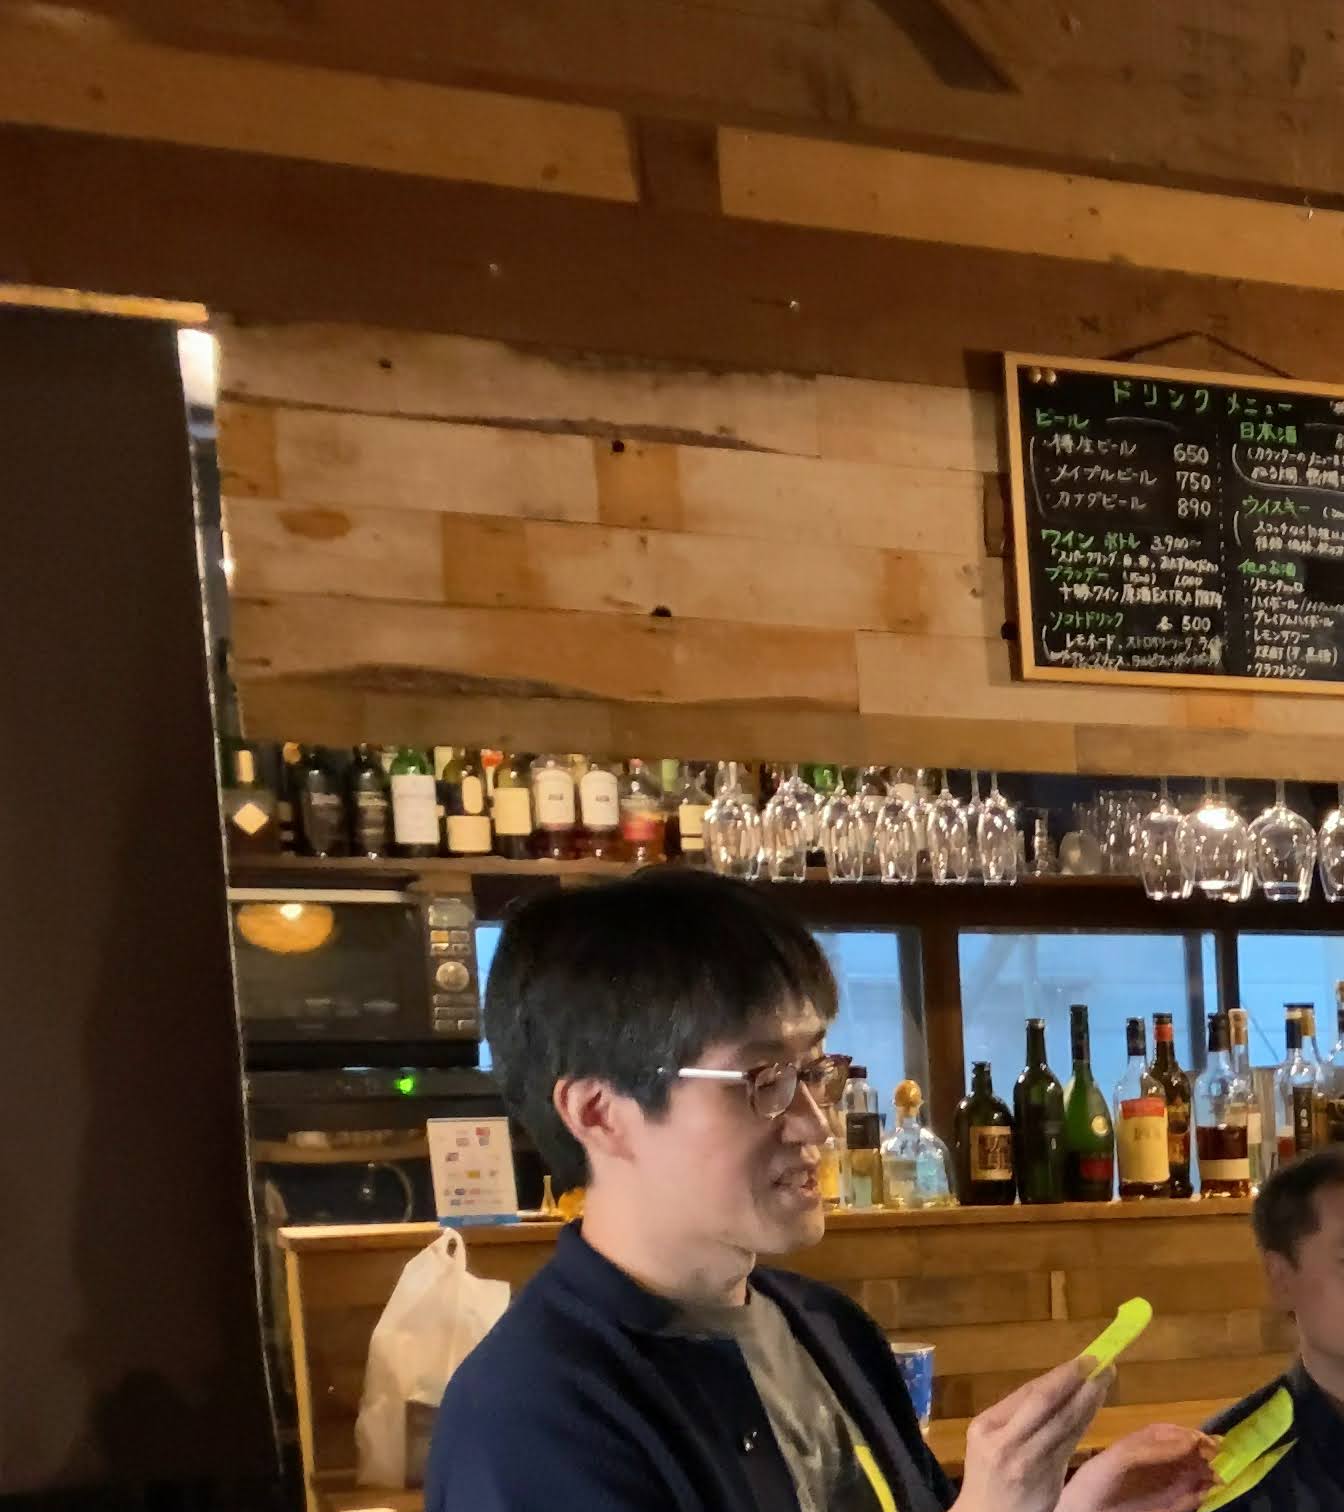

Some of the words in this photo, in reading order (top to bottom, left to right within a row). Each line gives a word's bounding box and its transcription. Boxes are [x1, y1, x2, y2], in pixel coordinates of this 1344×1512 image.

[1113, 380, 1209, 414] ドリンク
[1035, 408, 1090, 430] ビール
[1240, 422, 1297, 443] 日本酒
[1173, 443, 1209, 465] 650
[1176, 471, 1211, 492] 750
[1177, 497, 1211, 518] 890
[1041, 528, 1095, 549] ワイン
[1181, 615, 1211, 633] 500
